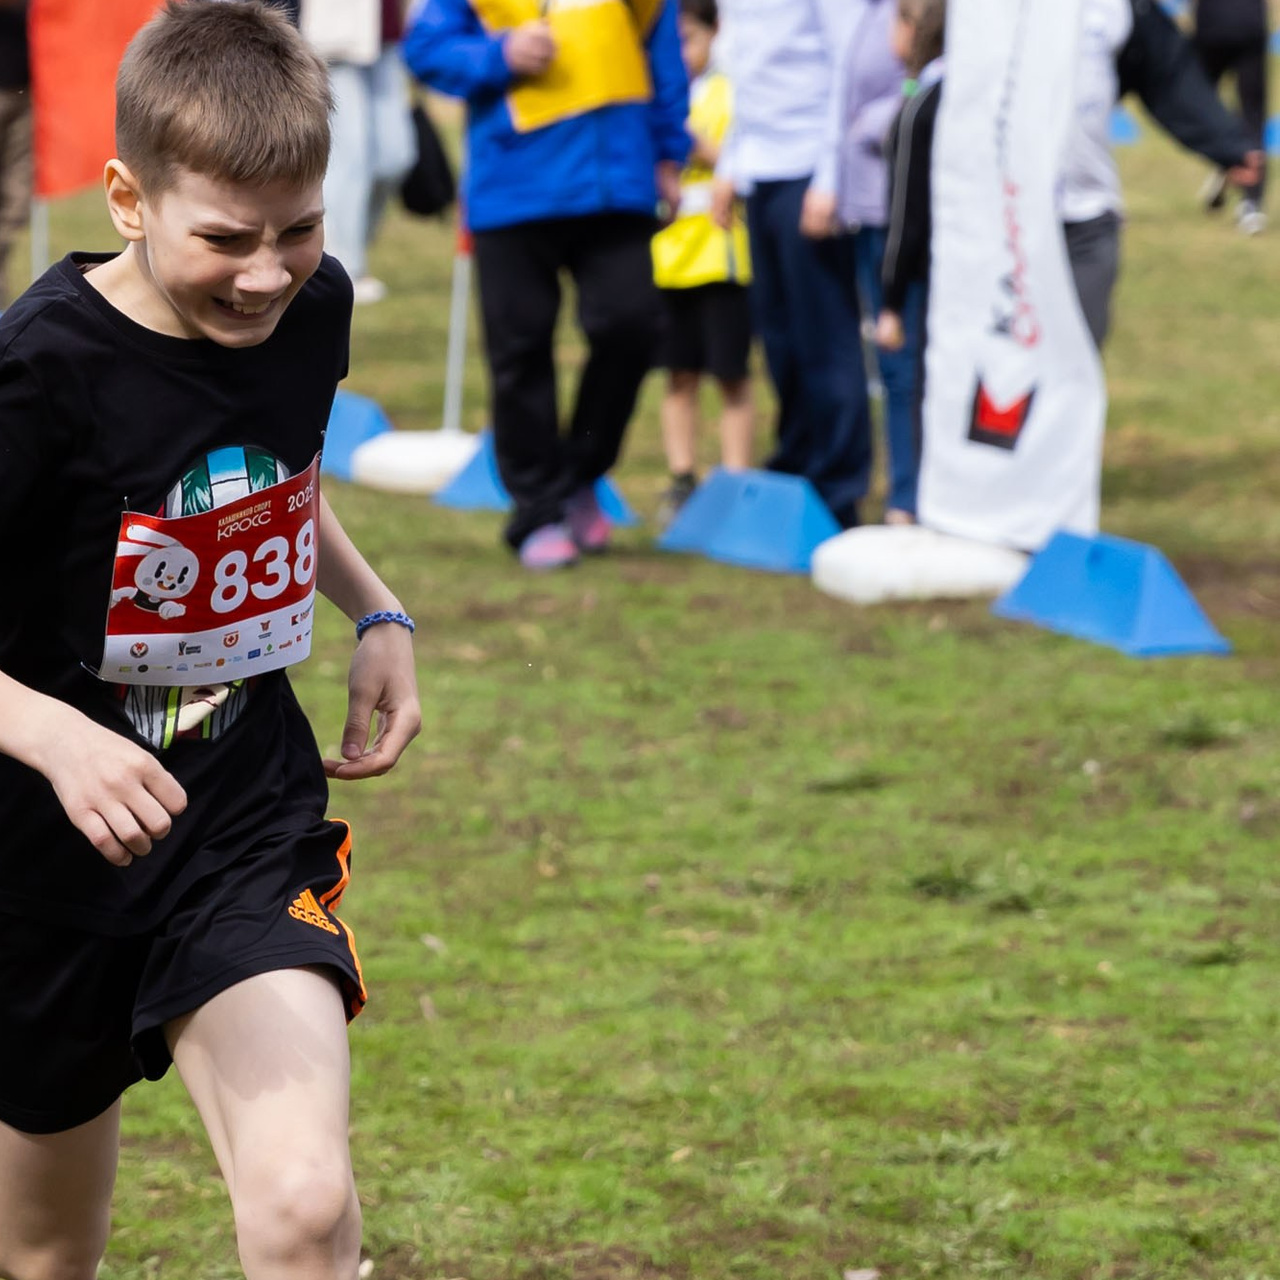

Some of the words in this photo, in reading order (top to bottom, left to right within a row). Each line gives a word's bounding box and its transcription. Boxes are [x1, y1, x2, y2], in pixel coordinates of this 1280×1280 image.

[287, 479, 314, 513] 2025
[217, 511, 271, 541] КРОСС
[210, 518, 316, 613] 838
[288, 906, 340, 936] adidas
